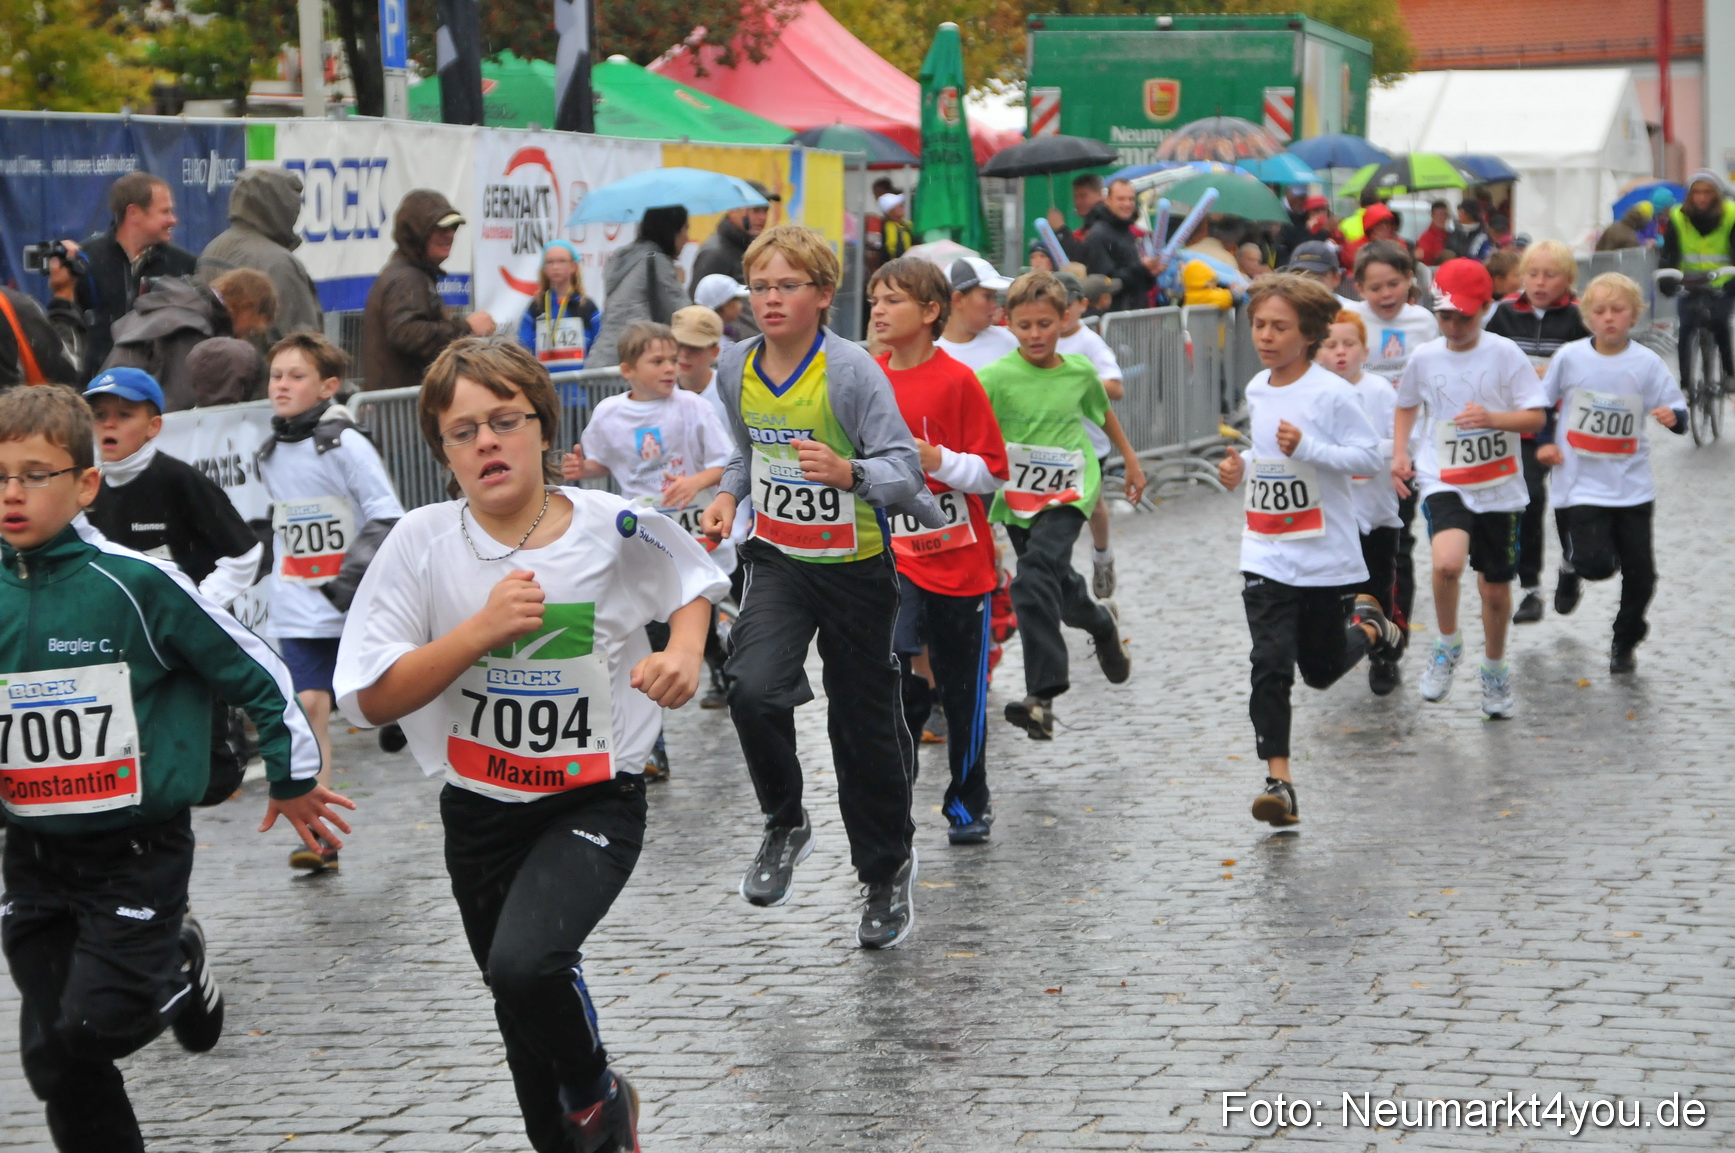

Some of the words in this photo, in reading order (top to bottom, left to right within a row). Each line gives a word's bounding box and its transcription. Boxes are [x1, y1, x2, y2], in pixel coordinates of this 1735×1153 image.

[541, 331, 577, 348] 742
[746, 411, 787, 426] TEAM
[1579, 406, 1634, 436] 7300
[1445, 431, 1507, 465] 7305
[759, 478, 840, 522] 7239
[1251, 480, 1309, 511] 7280
[279, 519, 344, 554] 7205
[911, 538, 942, 552] Nico
[48, 638, 96, 655] Bergler
[99, 638, 114, 653] C.
[9, 679, 78, 699] BOCK
[486, 668, 562, 686] BOCK
[0, 705, 113, 765] 7007
[461, 688, 592, 753] 7094
[3, 770, 117, 799] Constantin
[487, 754, 565, 787] Maxim
